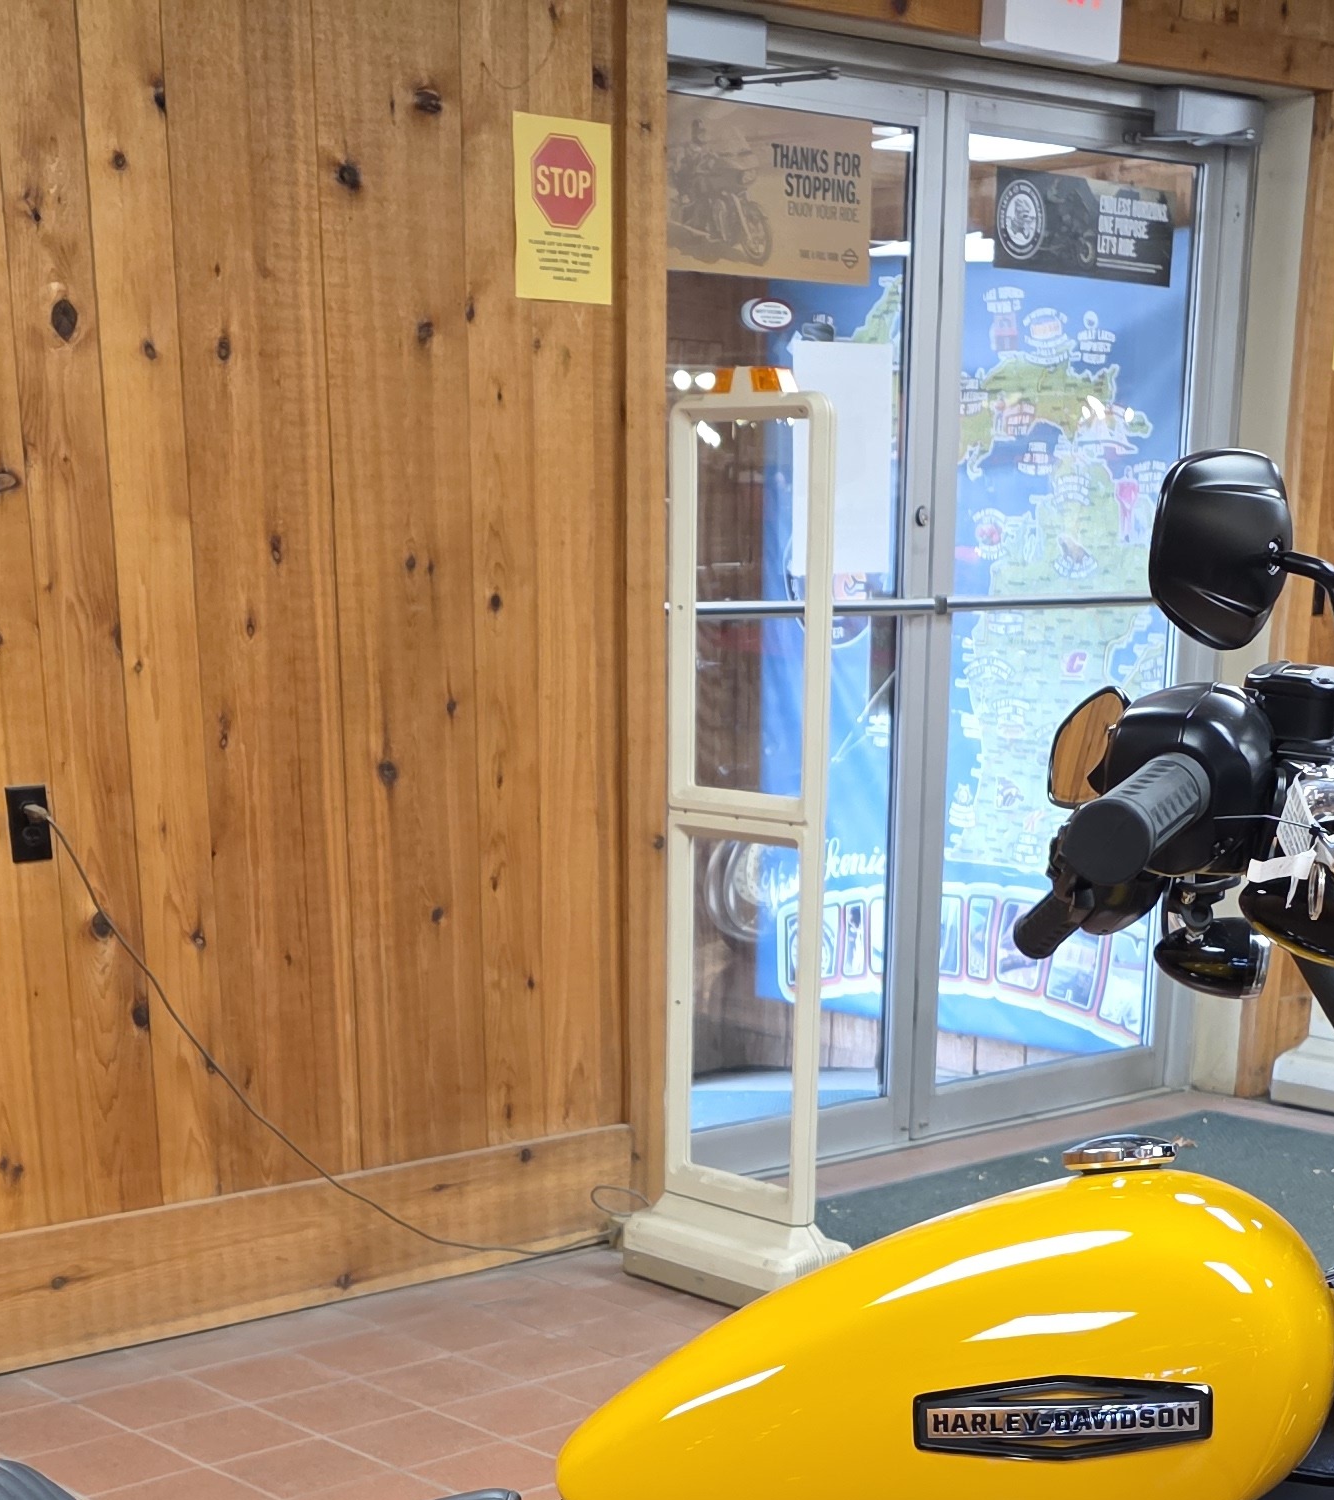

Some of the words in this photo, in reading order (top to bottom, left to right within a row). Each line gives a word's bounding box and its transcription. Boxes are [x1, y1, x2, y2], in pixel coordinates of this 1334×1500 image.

[771, 143, 829, 173] THANKS
[834, 151, 861, 178] FOR
[536, 165, 591, 199] STOP
[785, 173, 860, 205] STOPPING.
[788, 201, 812, 218] ENJOY
[815, 204, 837, 220] YOUR
[932, 1406, 1195, 1434] HARLEY-DAVIDSON
